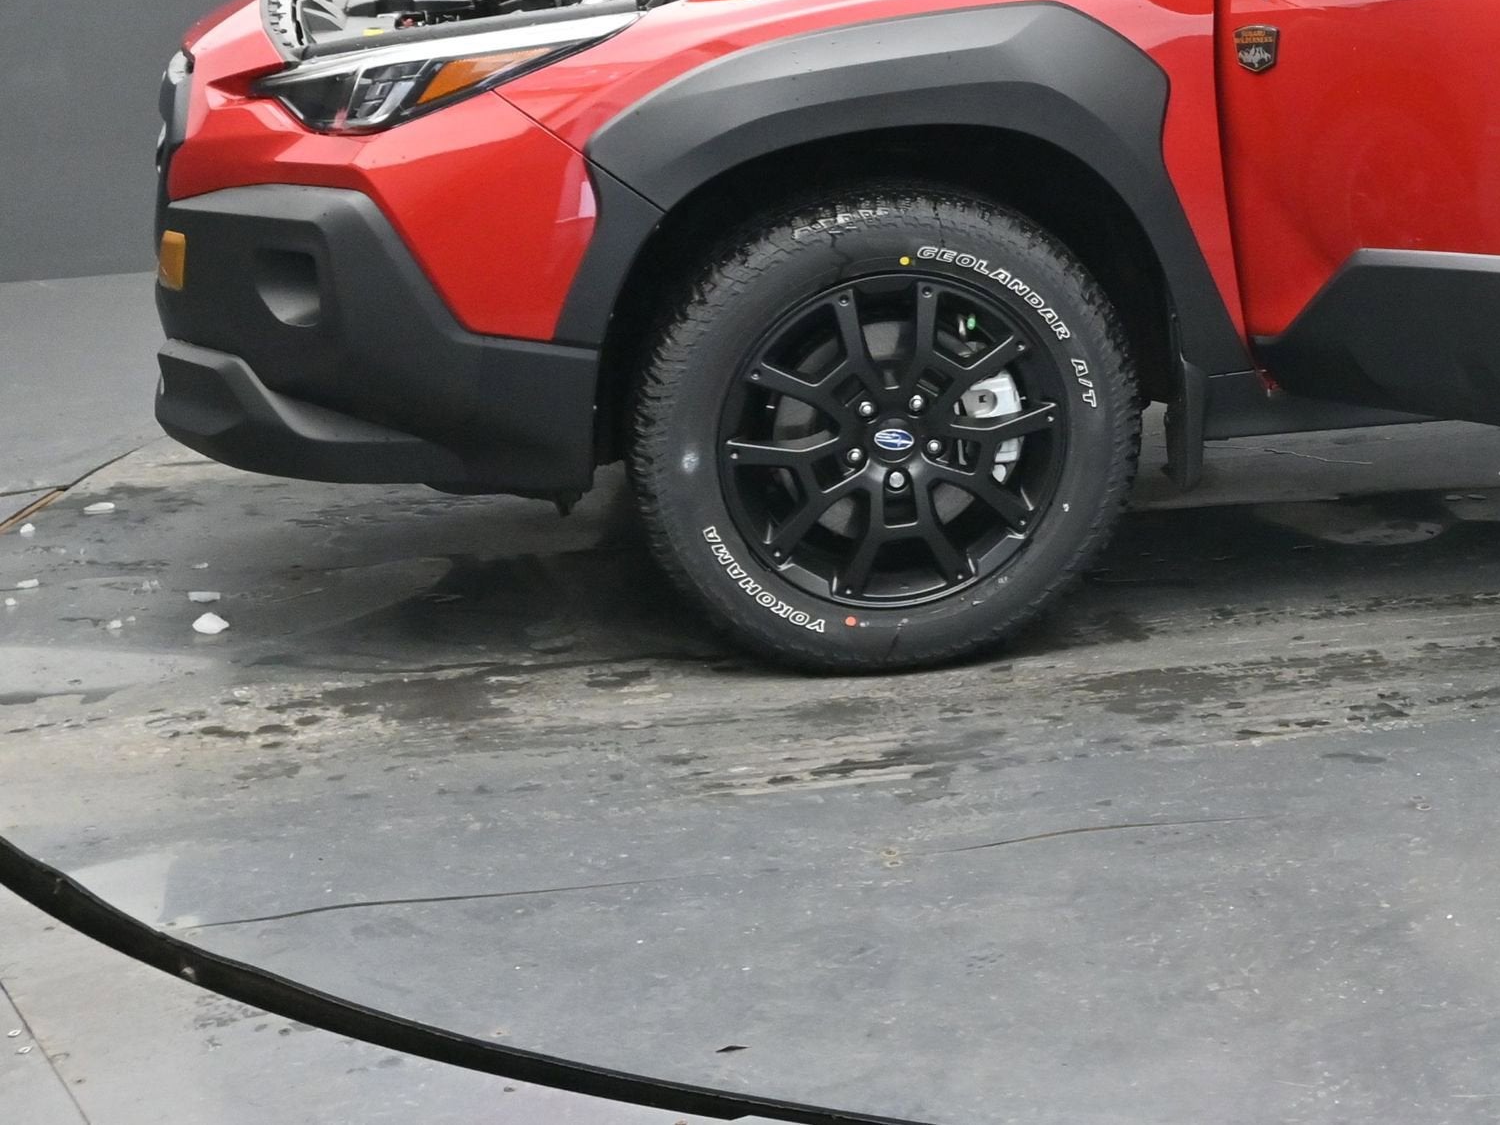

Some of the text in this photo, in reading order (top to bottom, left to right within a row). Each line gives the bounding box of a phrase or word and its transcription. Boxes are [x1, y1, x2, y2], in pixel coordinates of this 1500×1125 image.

[917, 246, 1097, 407] GEOLANDAR A/T
[703, 525, 825, 633] YOKOHAMA
